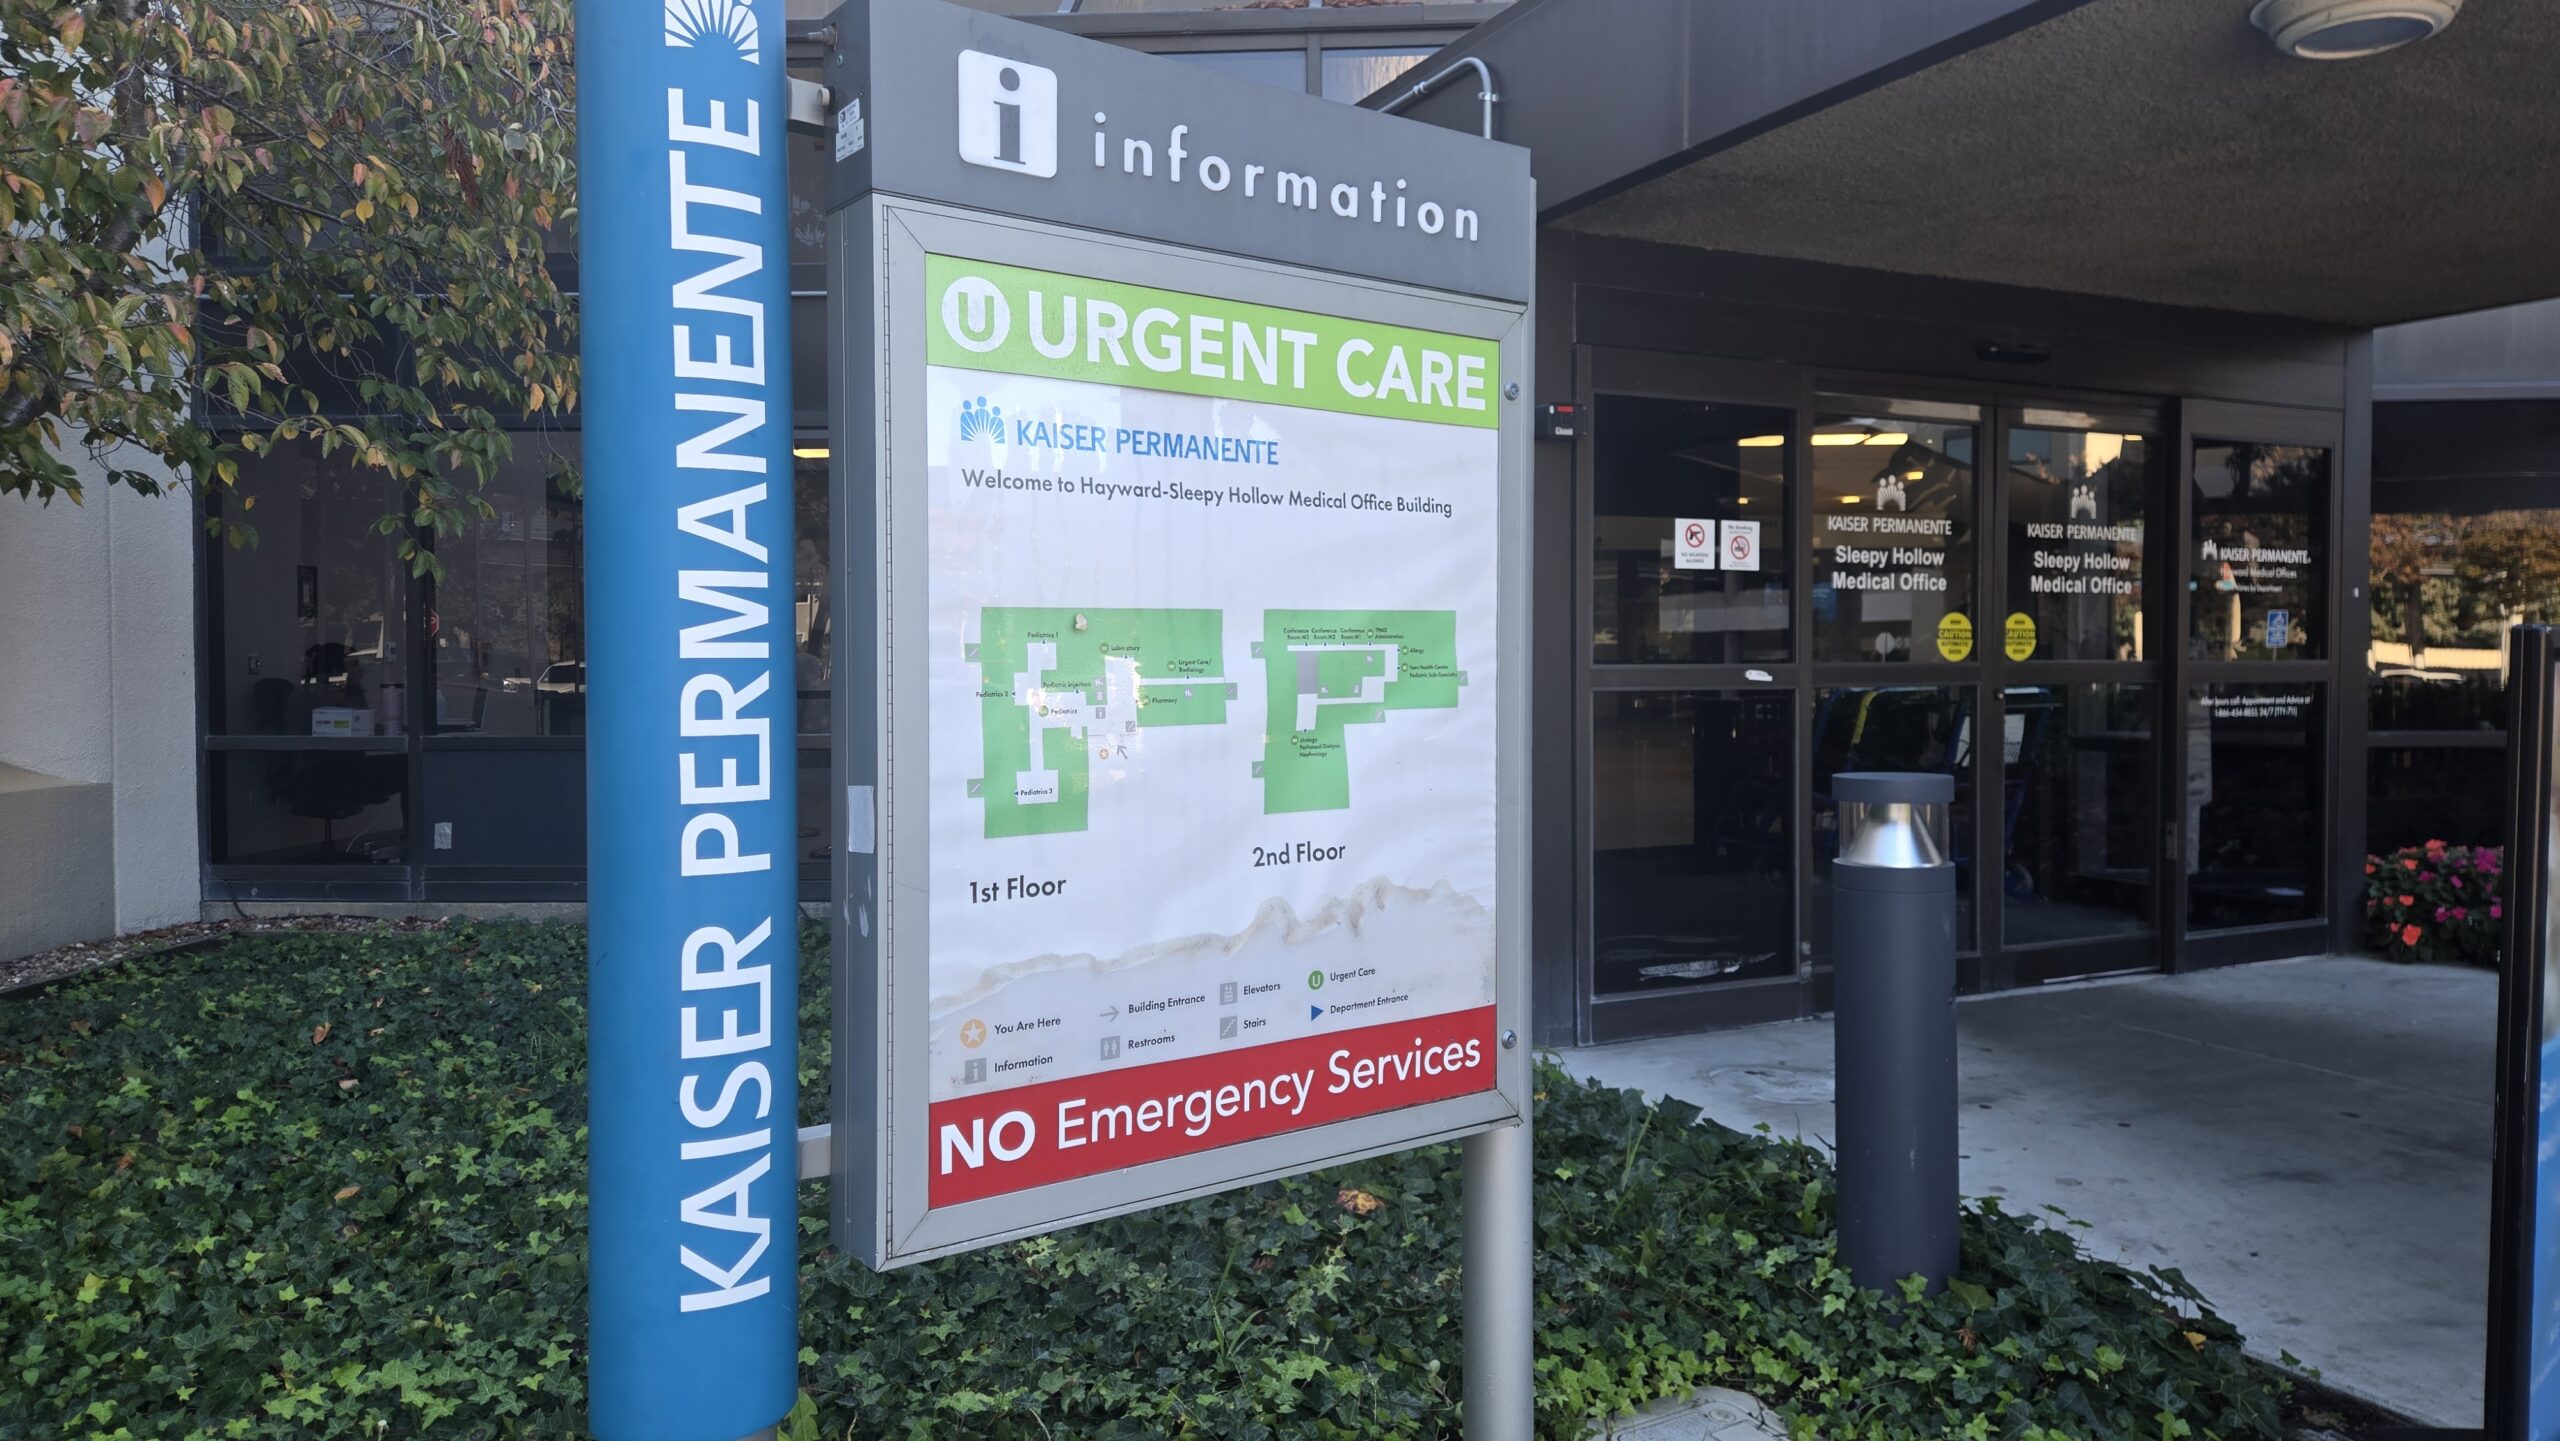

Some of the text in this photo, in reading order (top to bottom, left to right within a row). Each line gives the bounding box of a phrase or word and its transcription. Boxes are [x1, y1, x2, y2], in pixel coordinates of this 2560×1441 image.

[1094, 112, 1479, 242] information
[1027, 289, 1318, 390] URGENT
[1336, 338, 1487, 411] CARE
[1016, 419, 1280, 466] KAISER PERMANENTE
[961, 468, 1452, 518] Welcome to Hayward-Sleepy Hollow Medical Office Building
[1828, 515, 1953, 535] KAISER PERMANENTE
[2027, 523, 2137, 541] KAISER PERMANENTE
[1835, 545, 1945, 568] Sleepy Hollow
[2034, 551, 2131, 573] Sleepy Hollow
[2220, 547, 2249, 561] KAISER
[1832, 571, 1947, 591] Medical Office
[2030, 575, 2132, 594] Medical Office
[1939, 630, 1972, 639] CAUTION
[667, 88, 772, 1313] KAISER PERMANENTE
[2275, 694, 2286, 704] and
[1020, 788, 1046, 797] Pediatrics
[1253, 841, 1346, 868] 2nd Floor
[969, 875, 1067, 904] 1st Floor
[1330, 967, 1376, 982] Urgent Care
[1243, 982, 1281, 996] Elevators
[1128, 993, 1205, 1014] Building Entrance
[1330, 993, 1408, 1014] Department Entrance
[994, 1016, 1061, 1035] You Are Here
[1243, 1018, 1267, 1029] Stairs
[1128, 1033, 1175, 1050] Restrooms
[994, 1054, 1053, 1073] Information
[939, 1037, 1482, 1175] NO Emergency Services
